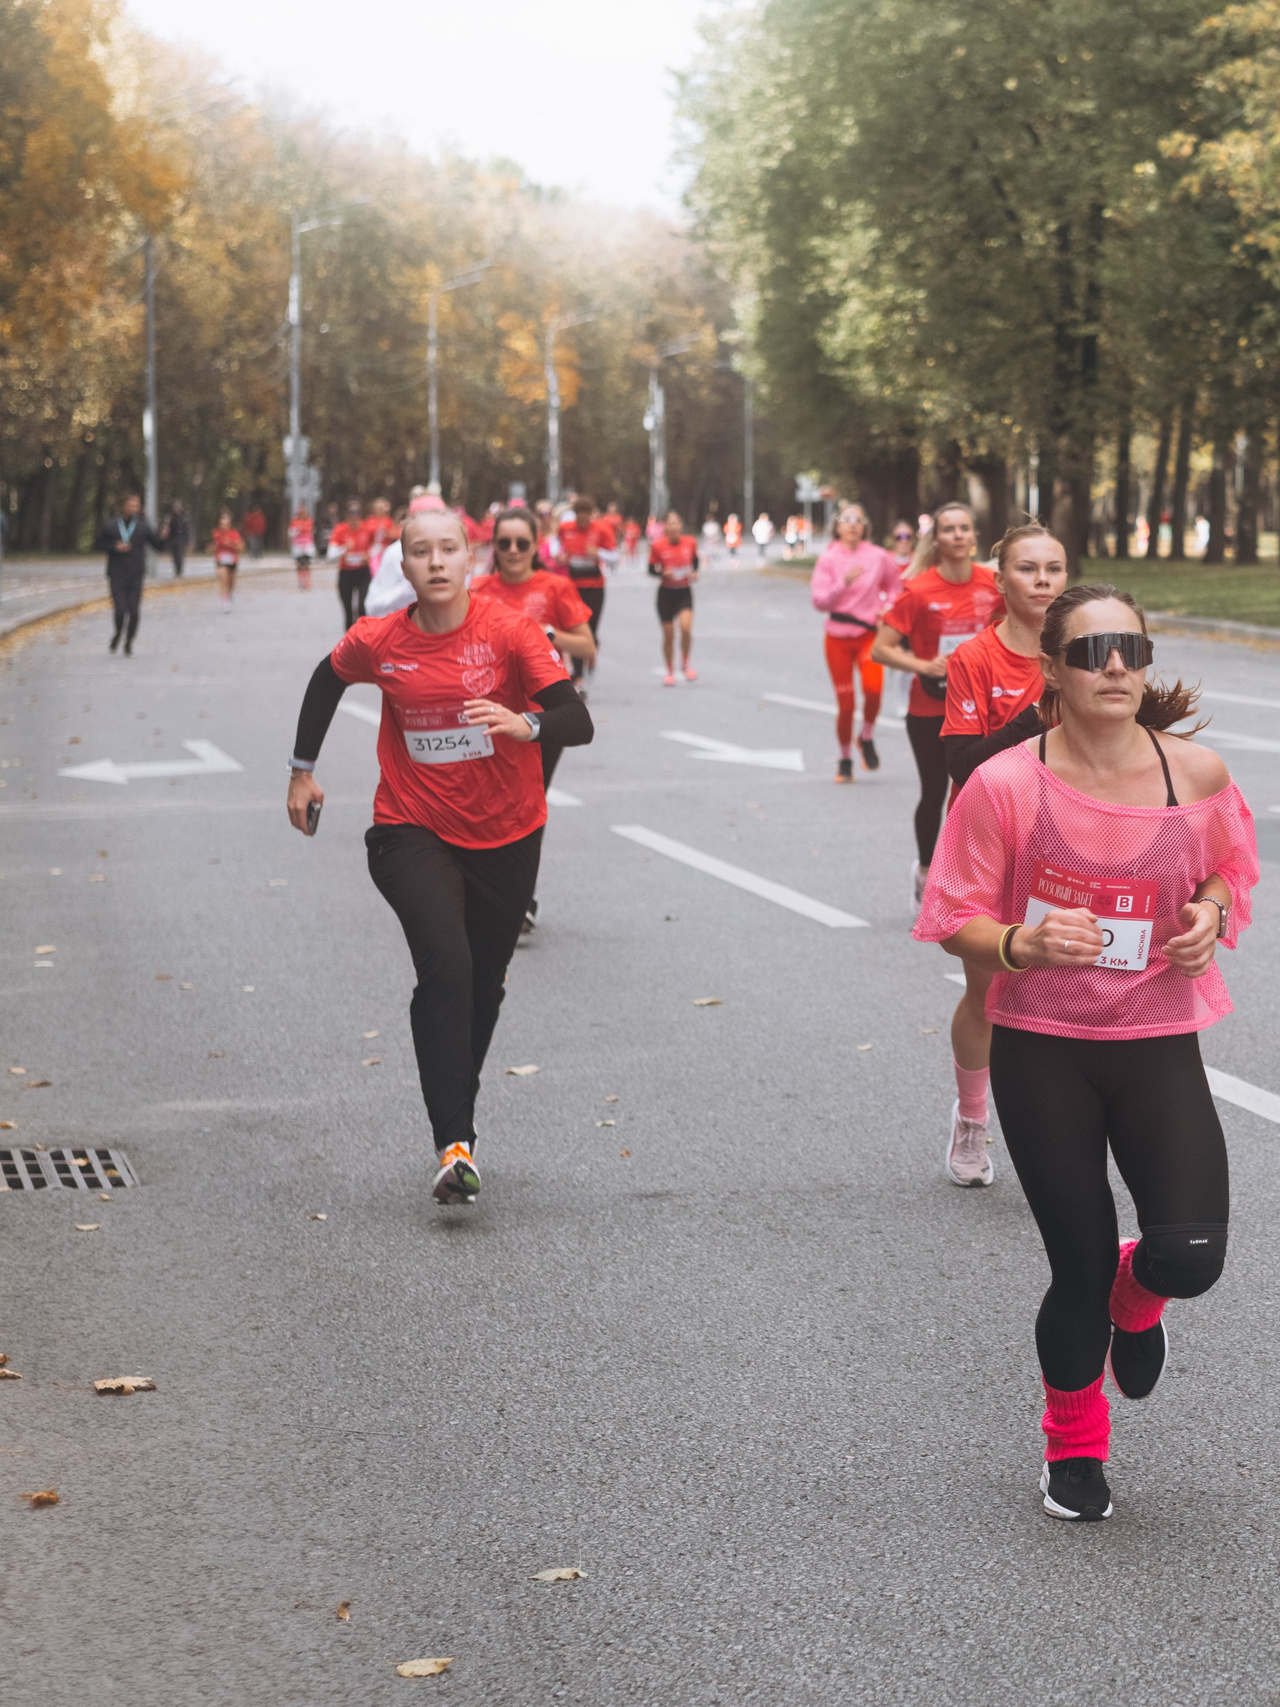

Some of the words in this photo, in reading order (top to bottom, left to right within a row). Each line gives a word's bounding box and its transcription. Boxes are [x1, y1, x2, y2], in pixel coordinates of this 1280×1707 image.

[413, 735, 472, 751] 31254
[1038, 878, 1072, 902] РОЗОВЫЙ
[1072, 889, 1095, 907] ЗАБЕГ
[1137, 929, 1147, 960] МОСКВА
[1100, 956, 1107, 965] 3
[1110, 957, 1129, 967] КМ
